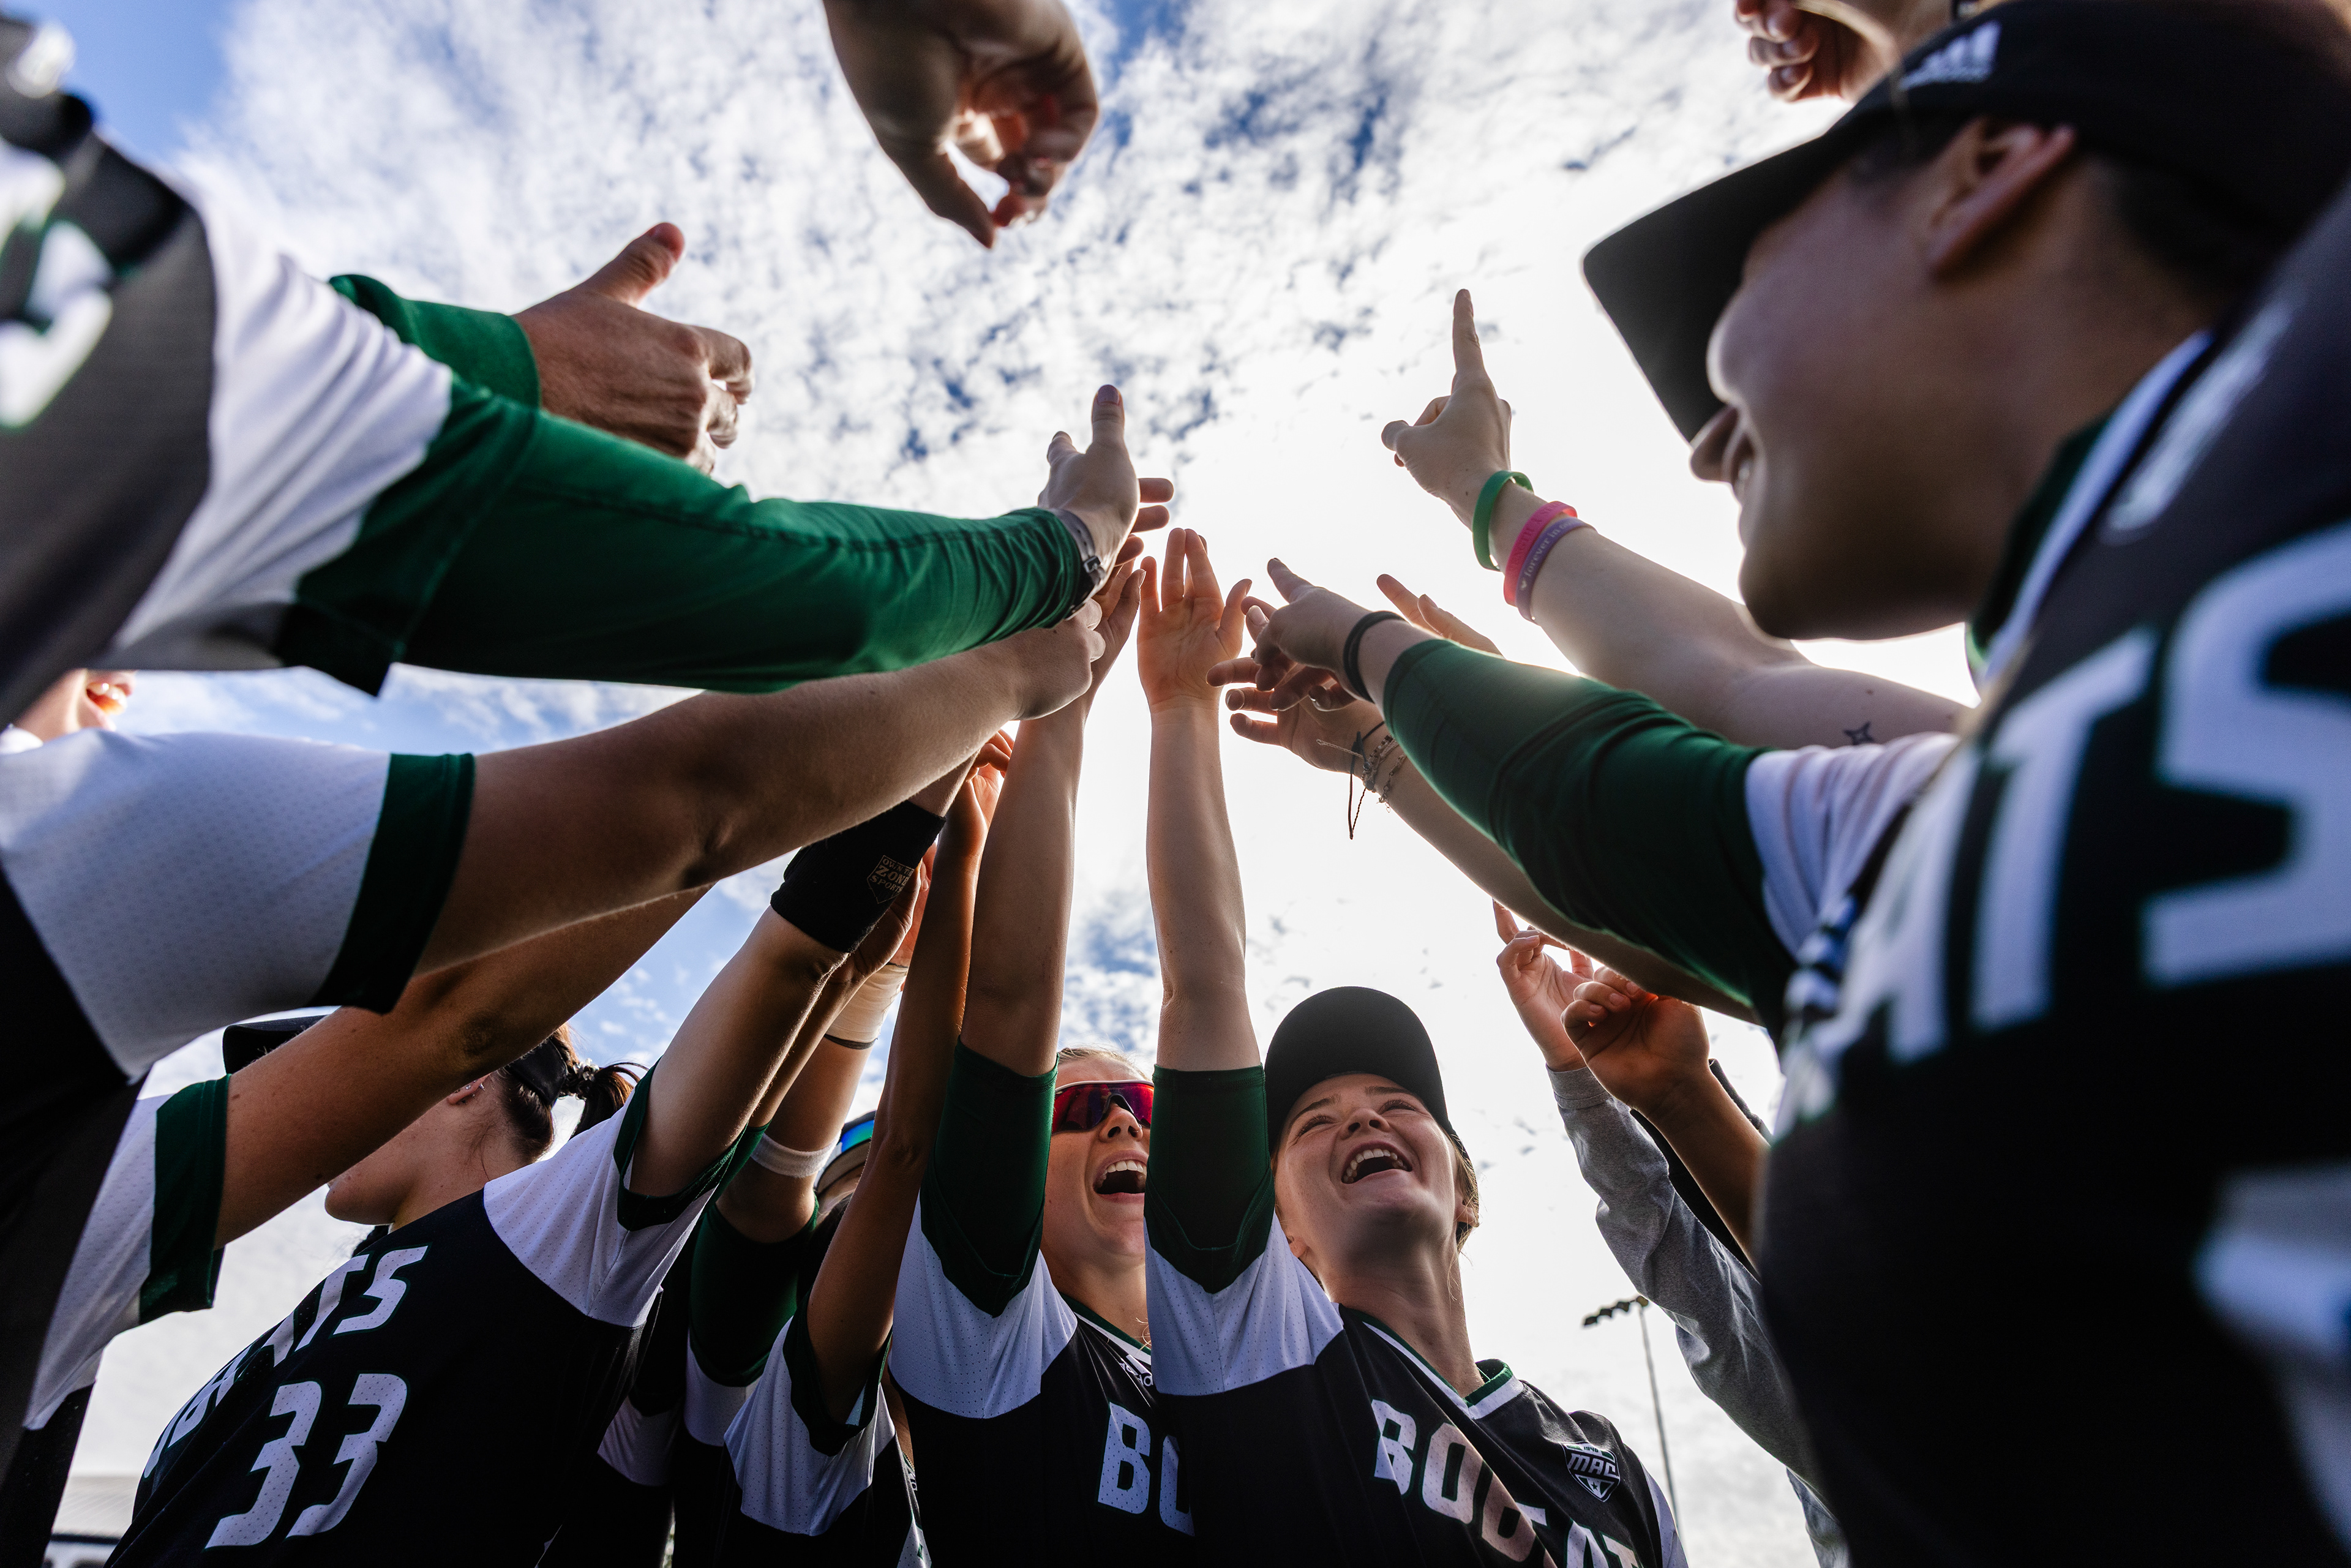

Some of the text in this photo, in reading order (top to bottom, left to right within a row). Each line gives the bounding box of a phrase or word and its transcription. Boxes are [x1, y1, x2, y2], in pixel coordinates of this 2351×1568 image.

[875, 865, 910, 887] ZONE
[882, 858, 903, 872] OWN
[869, 875, 904, 893] SPORTS
[205, 1373, 408, 1550] 33
[1567, 1452, 1620, 1479] MAC
